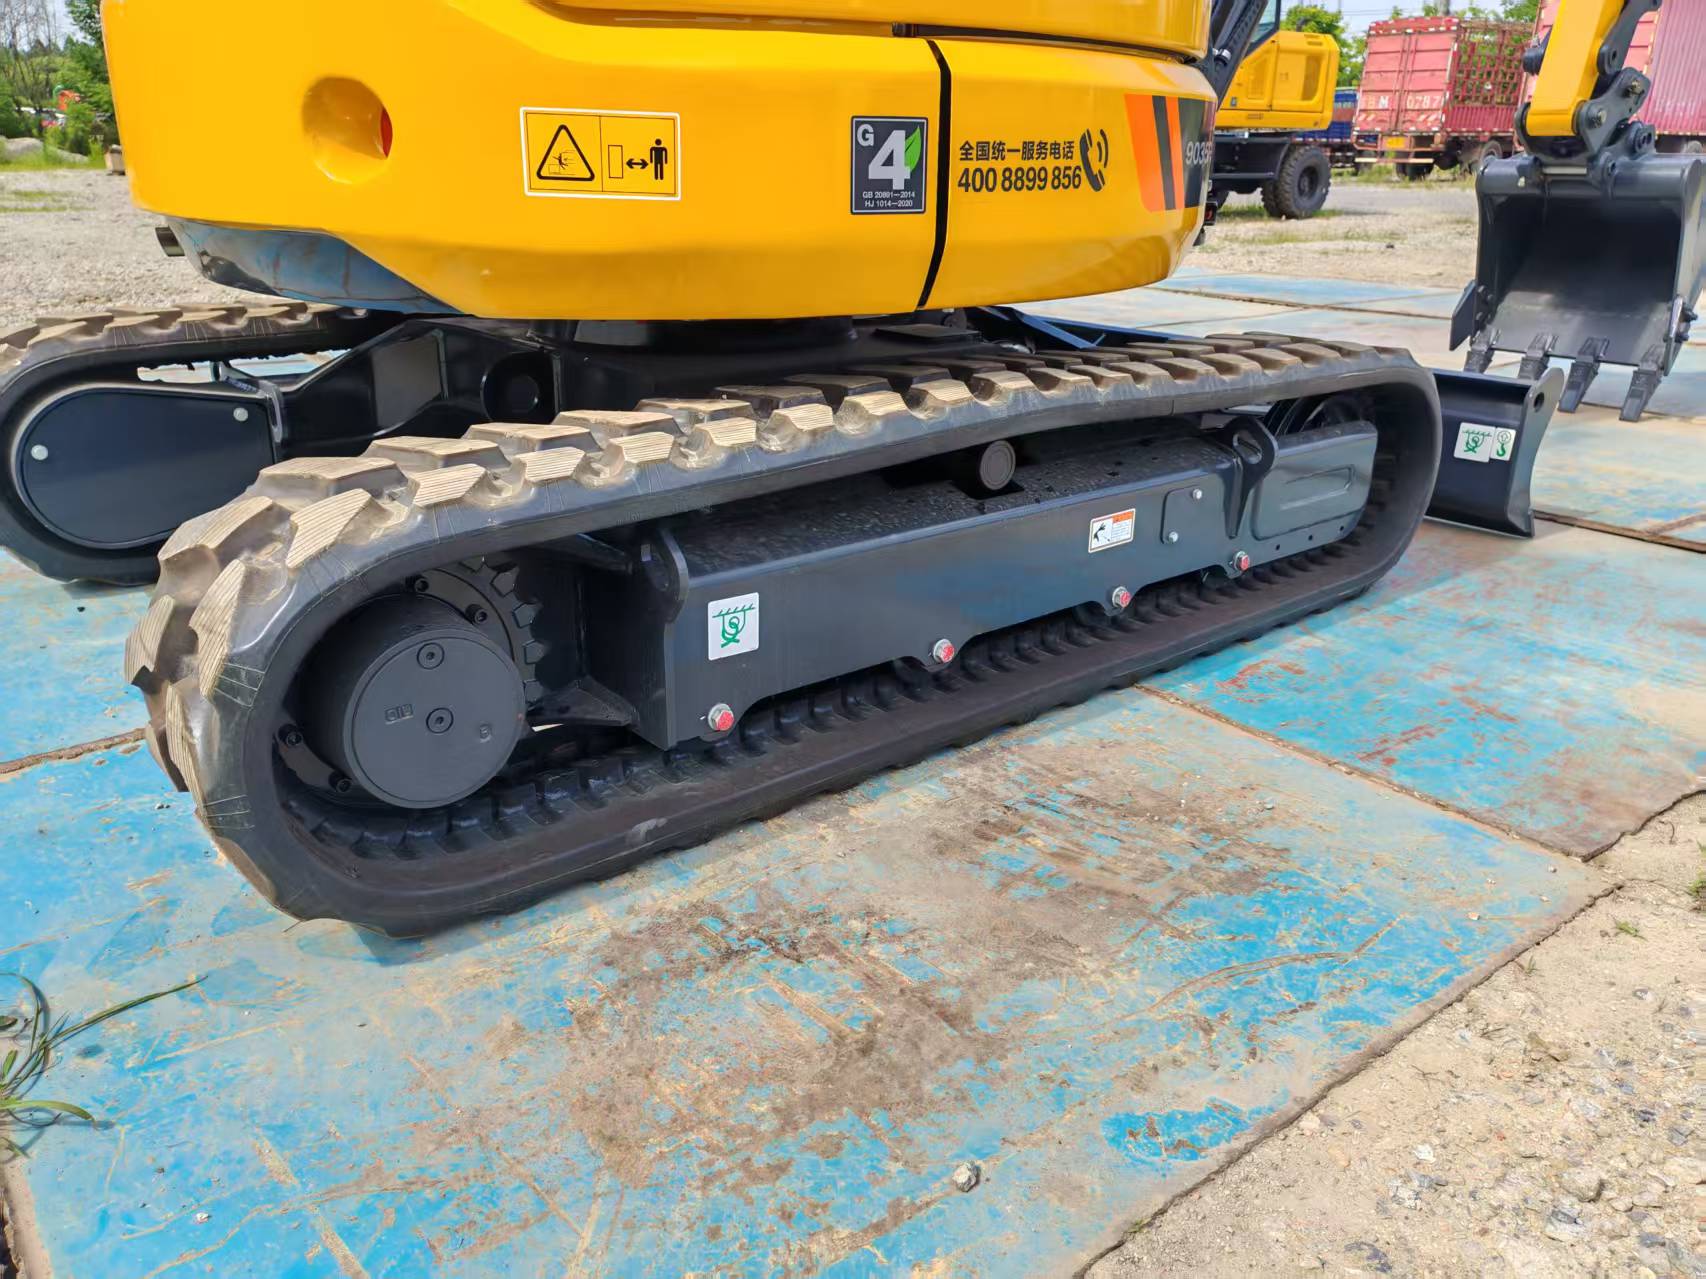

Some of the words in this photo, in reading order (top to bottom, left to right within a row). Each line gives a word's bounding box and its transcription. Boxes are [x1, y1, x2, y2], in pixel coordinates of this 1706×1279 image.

[857, 123, 874, 147] G
[868, 129, 911, 190] 4
[959, 140, 1075, 161] 全国统一服务电话
[957, 167, 998, 193] 400
[1000, 166, 1049, 191] 8899
[1050, 165, 1082, 190] 856
[862, 191, 873, 199] GB
[864, 199, 874, 207] HJ
